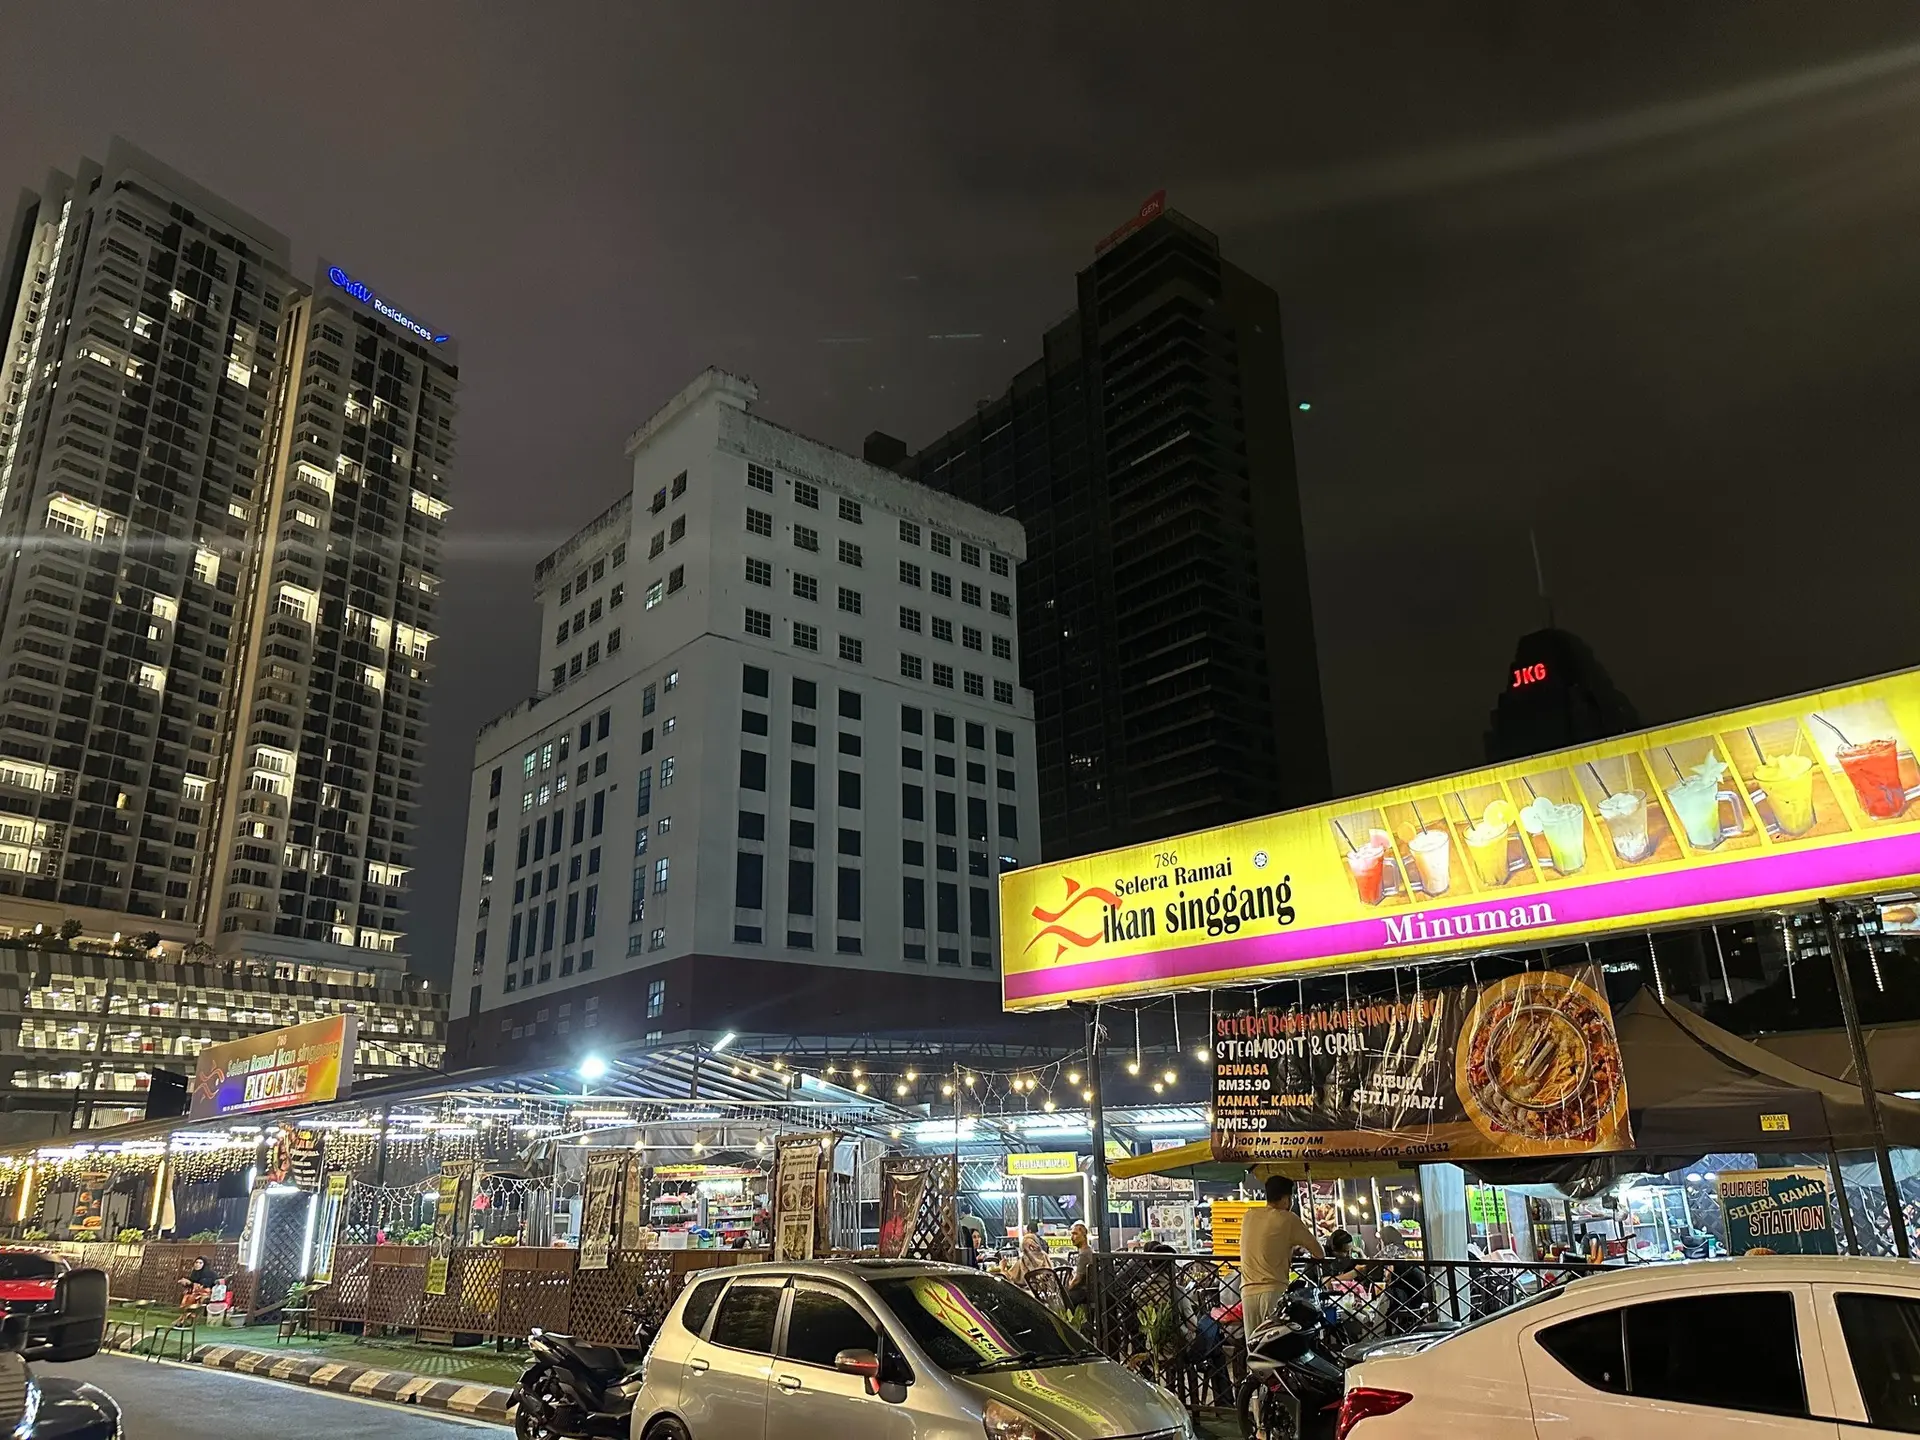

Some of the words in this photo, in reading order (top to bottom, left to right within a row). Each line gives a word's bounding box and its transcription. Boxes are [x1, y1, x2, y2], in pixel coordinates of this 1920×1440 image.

[374, 299, 432, 341] Residences
[1512, 663, 1546, 688] JKG
[1154, 850, 1178, 869] 786
[1115, 873, 1169, 897] Selera
[1175, 856, 1232, 886] Ramai
[1103, 902, 1156, 944] ikan
[1165, 874, 1296, 937] singgang
[1381, 902, 1557, 946] Minuman
[1216, 1014, 1265, 1037] SELERA
[1216, 1036, 1307, 1061] STEAMBOAT
[1311, 1035, 1322, 1055] &
[1325, 1032, 1369, 1057] GRILL
[1217, 1063, 1269, 1076] DEWASA
[1217, 1079, 1271, 1091] RM35.90
[1372, 1073, 1424, 1091] DIBUKA
[1217, 1095, 1259, 1107] KANAK
[1271, 1094, 1314, 1107] KANAK
[1352, 1089, 1399, 1107] SETIAP
[1216, 1117, 1267, 1130] RM15.90
[1255, 1137, 1270, 1146] PM
[1279, 1136, 1305, 1146] 12:00
[1306, 1136, 1323, 1145] AM
[1720, 1180, 1770, 1197] BURGER
[1729, 1197, 1778, 1220] SELERA
[1778, 1182, 1823, 1205] RAMAI
[1749, 1205, 1826, 1237] STATION
